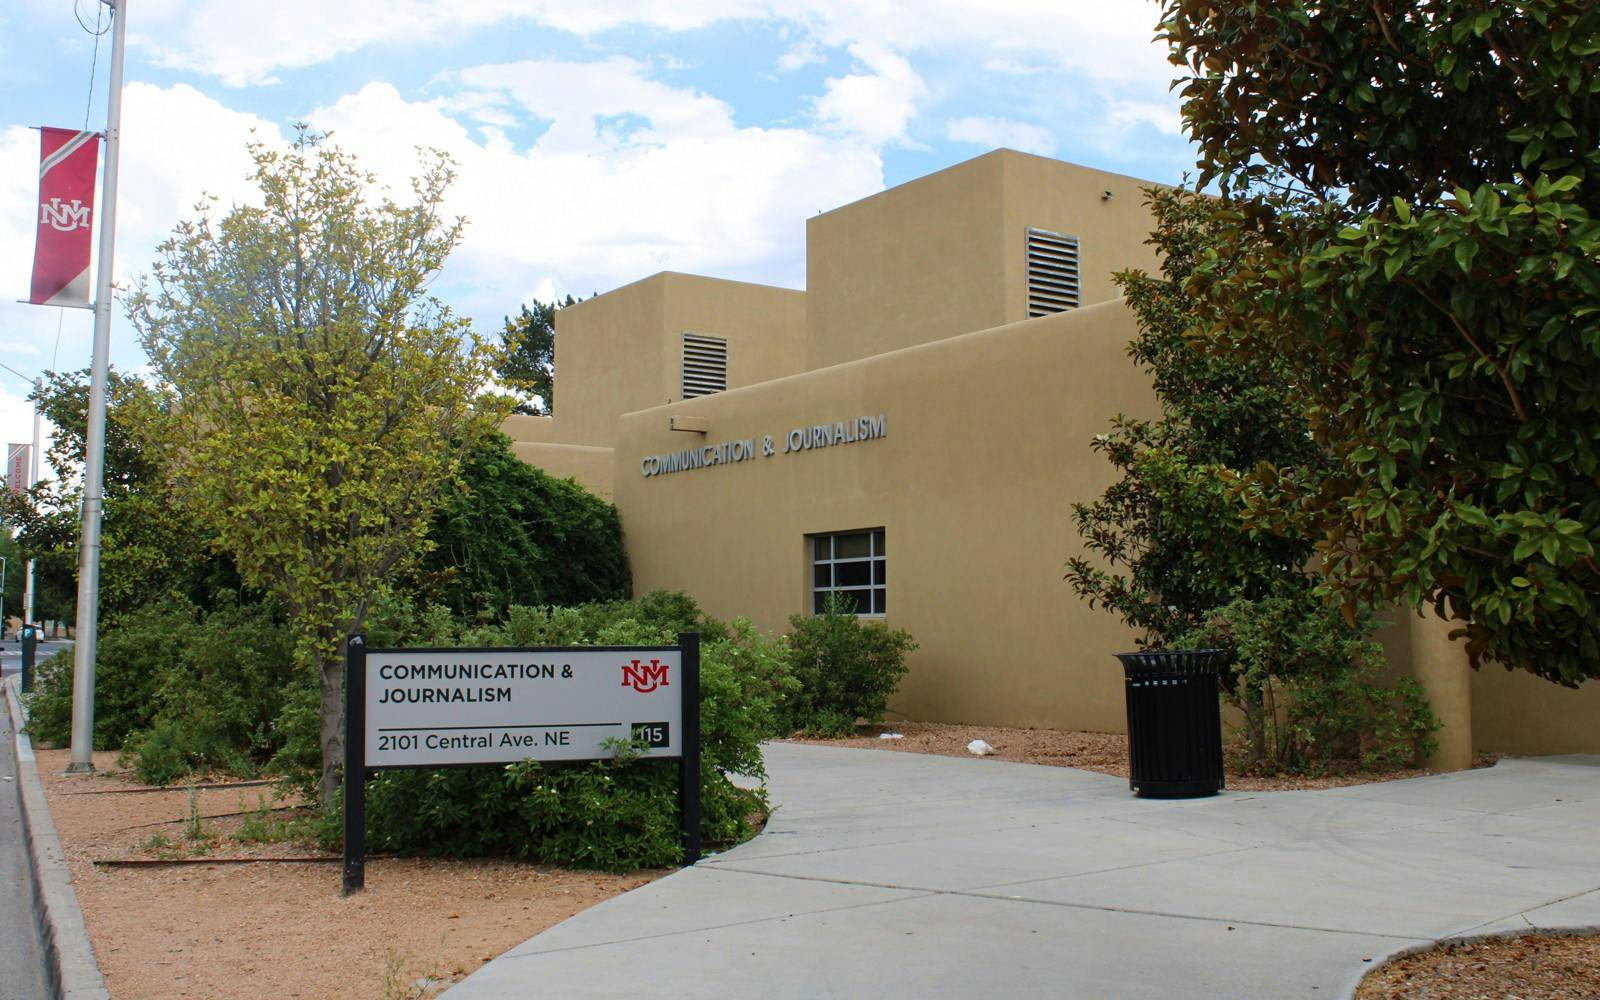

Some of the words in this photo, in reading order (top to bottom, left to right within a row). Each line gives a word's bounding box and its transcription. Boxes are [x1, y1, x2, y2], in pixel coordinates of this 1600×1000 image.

[641, 438, 756, 477] COMMUNICATION
[762, 435, 775, 457] &
[783, 414, 887, 454] JOURNALISM
[379, 664, 554, 680] COMMUNICATION
[561, 664, 573, 679] &
[379, 687, 512, 703] JOURNALISM
[378, 735, 418, 750] 2101
[425, 733, 493, 749] Central
[499, 732, 538, 747] Ave.
[545, 731, 570, 746] NE
